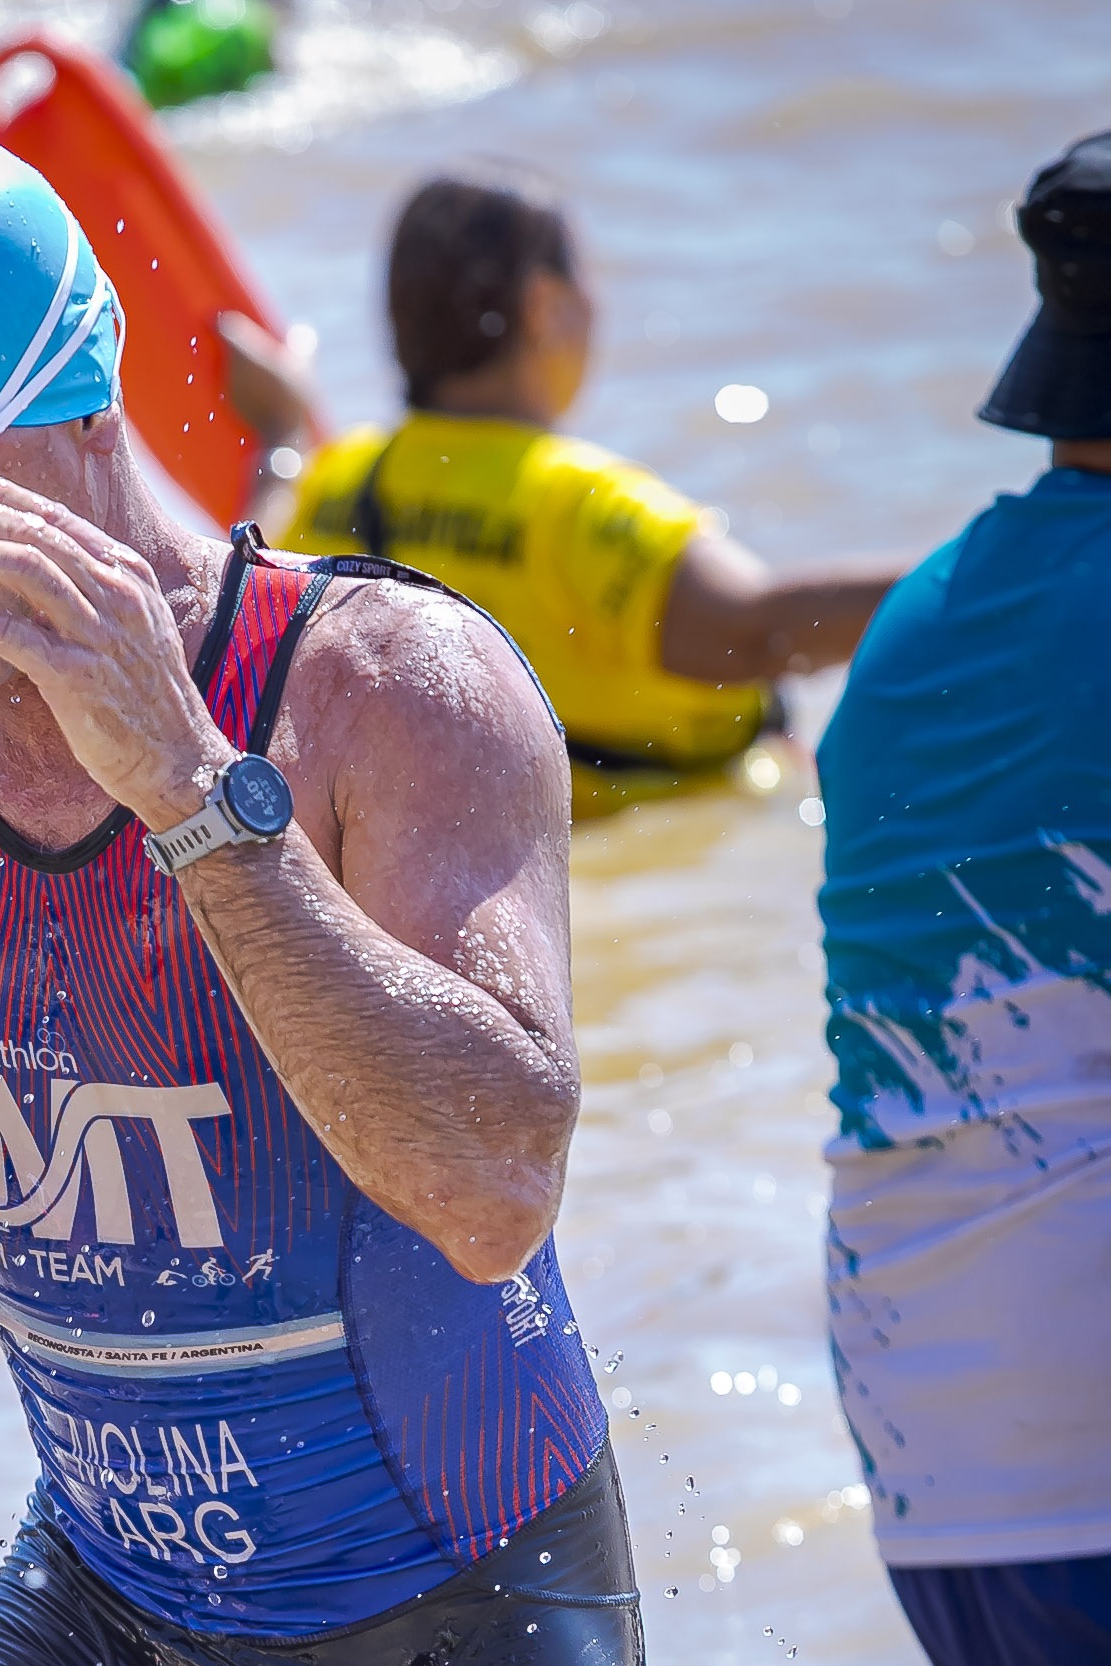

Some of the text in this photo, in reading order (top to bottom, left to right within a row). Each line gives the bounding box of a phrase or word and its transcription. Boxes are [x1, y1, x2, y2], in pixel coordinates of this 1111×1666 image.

[336, 560, 361, 573] COZY
[362, 563, 392, 577] SPORT
[27, 1248, 126, 1287] TEAM
[27, 1331, 95, 1358] RECONQUISTA
[104, 1350, 149, 1361] SANTA
[151, 1352, 168, 1361] FE
[180, 1342, 264, 1360] ARGENTINA
[109, 1496, 257, 1565] ARG
